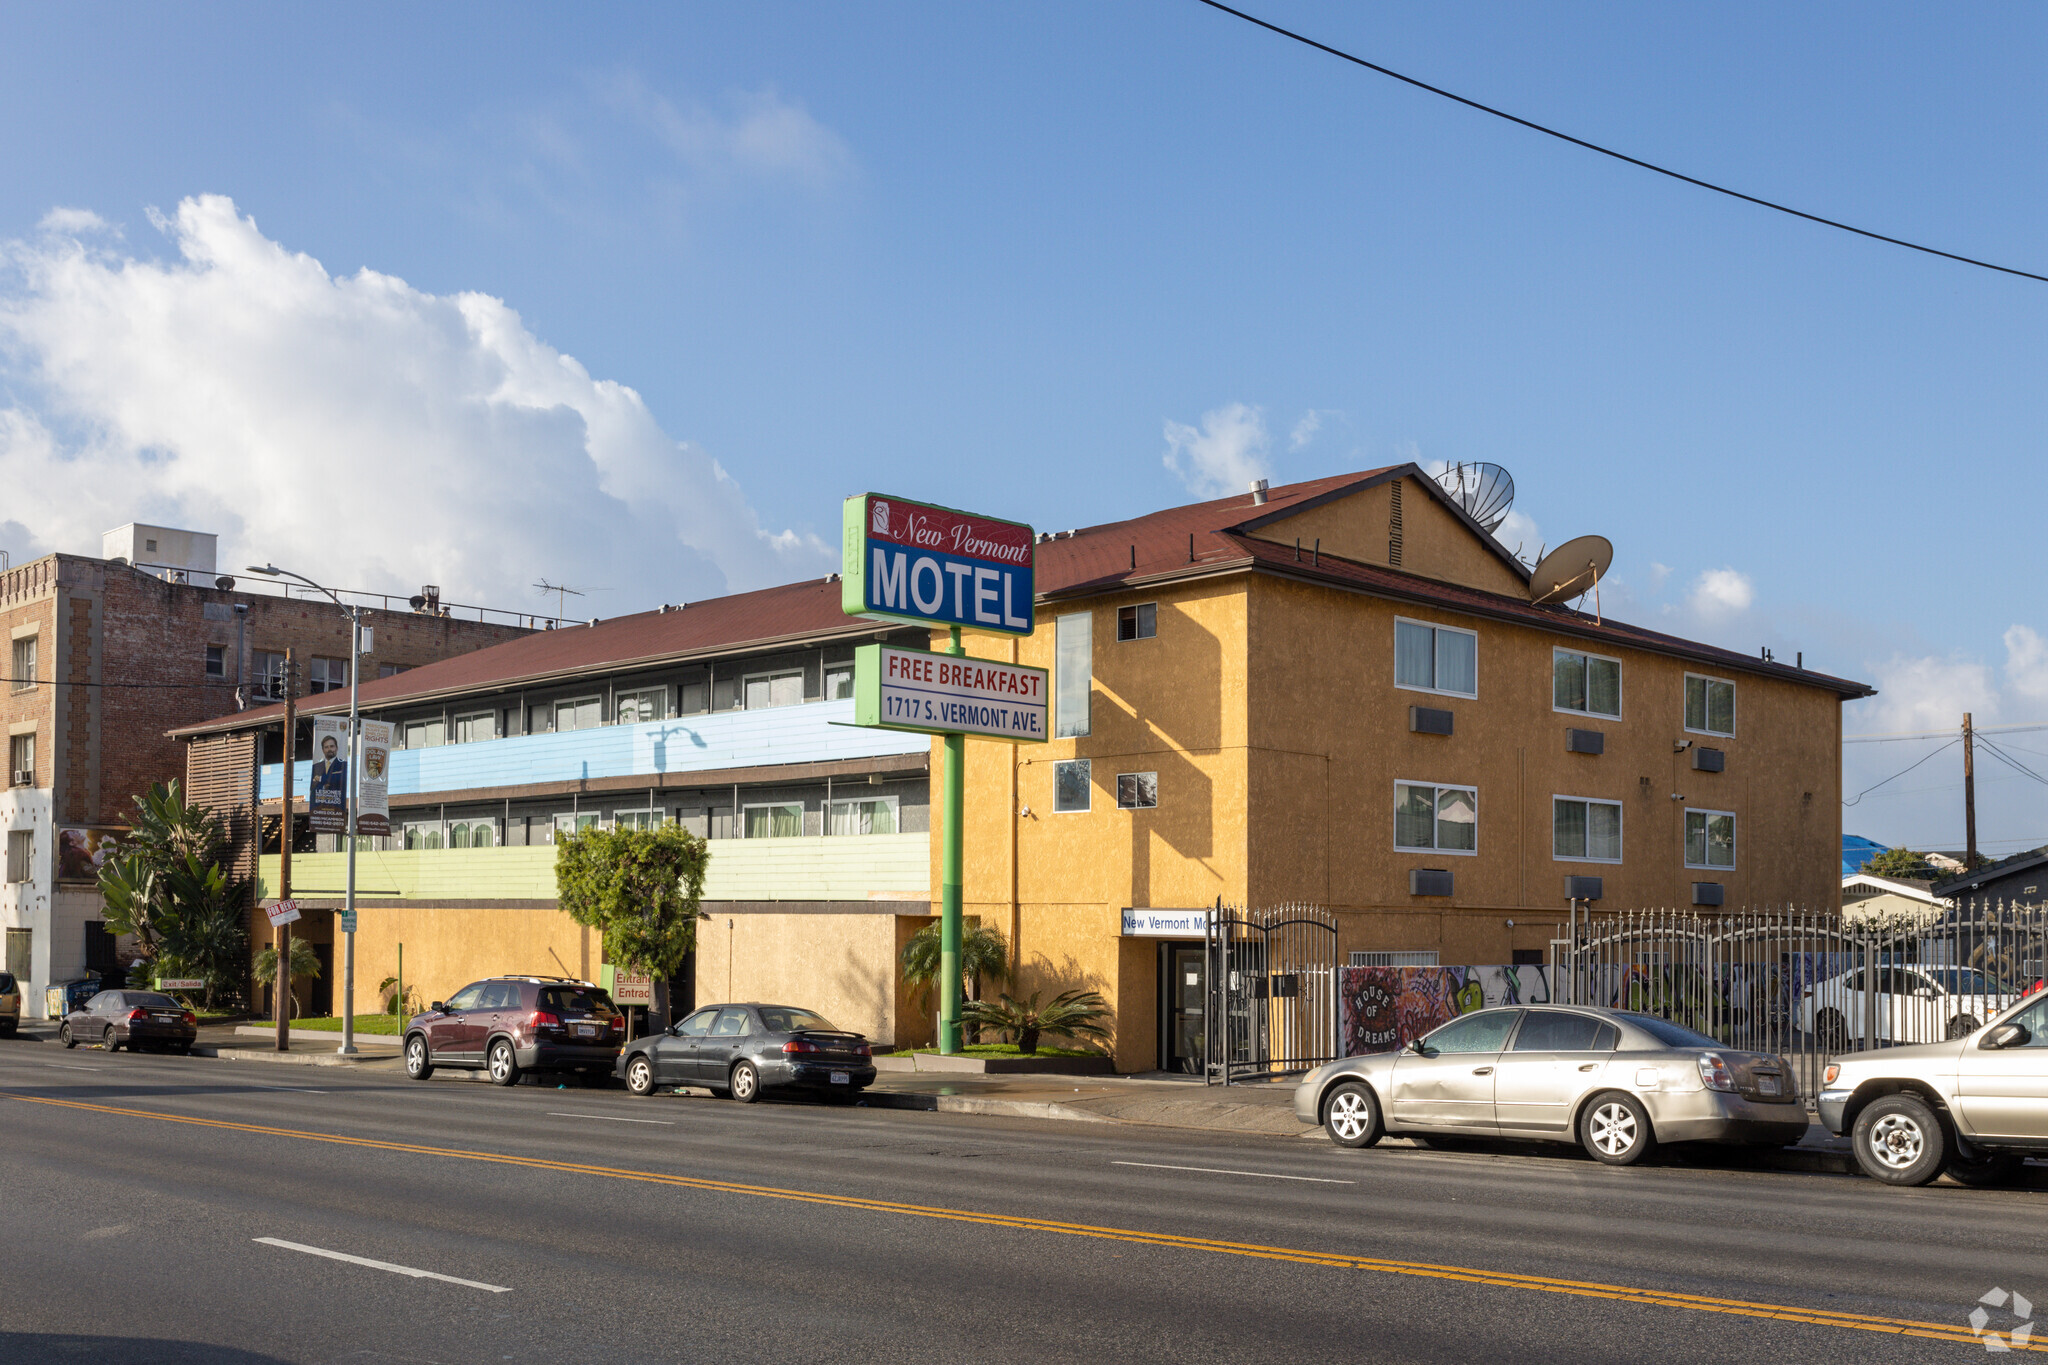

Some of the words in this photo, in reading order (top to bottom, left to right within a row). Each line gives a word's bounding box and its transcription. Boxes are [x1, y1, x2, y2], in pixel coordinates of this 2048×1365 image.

[894, 513, 945, 546] New
[951, 524, 1029, 562] Vermont
[873, 548, 1028, 628] MOTEL
[889, 655, 933, 682] FREE
[939, 663, 1040, 696] BREAKFAST
[886, 696, 920, 719] 1717
[925, 700, 937, 721] S.
[941, 702, 1008, 729] VERMONT
[1012, 711, 1041, 733] AVE.
[365, 735, 388, 743] RIGHTS
[267, 905, 281, 917] FOR
[279, 900, 296, 913] RENT
[1124, 915, 1144, 928] New
[1149, 916, 1190, 929] Vermont
[617, 973, 650, 983] Entran
[1356, 986, 1390, 1009] HOUSE
[1366, 1005, 1377, 1017] OF
[1357, 1026, 1397, 1044] DREAMS
